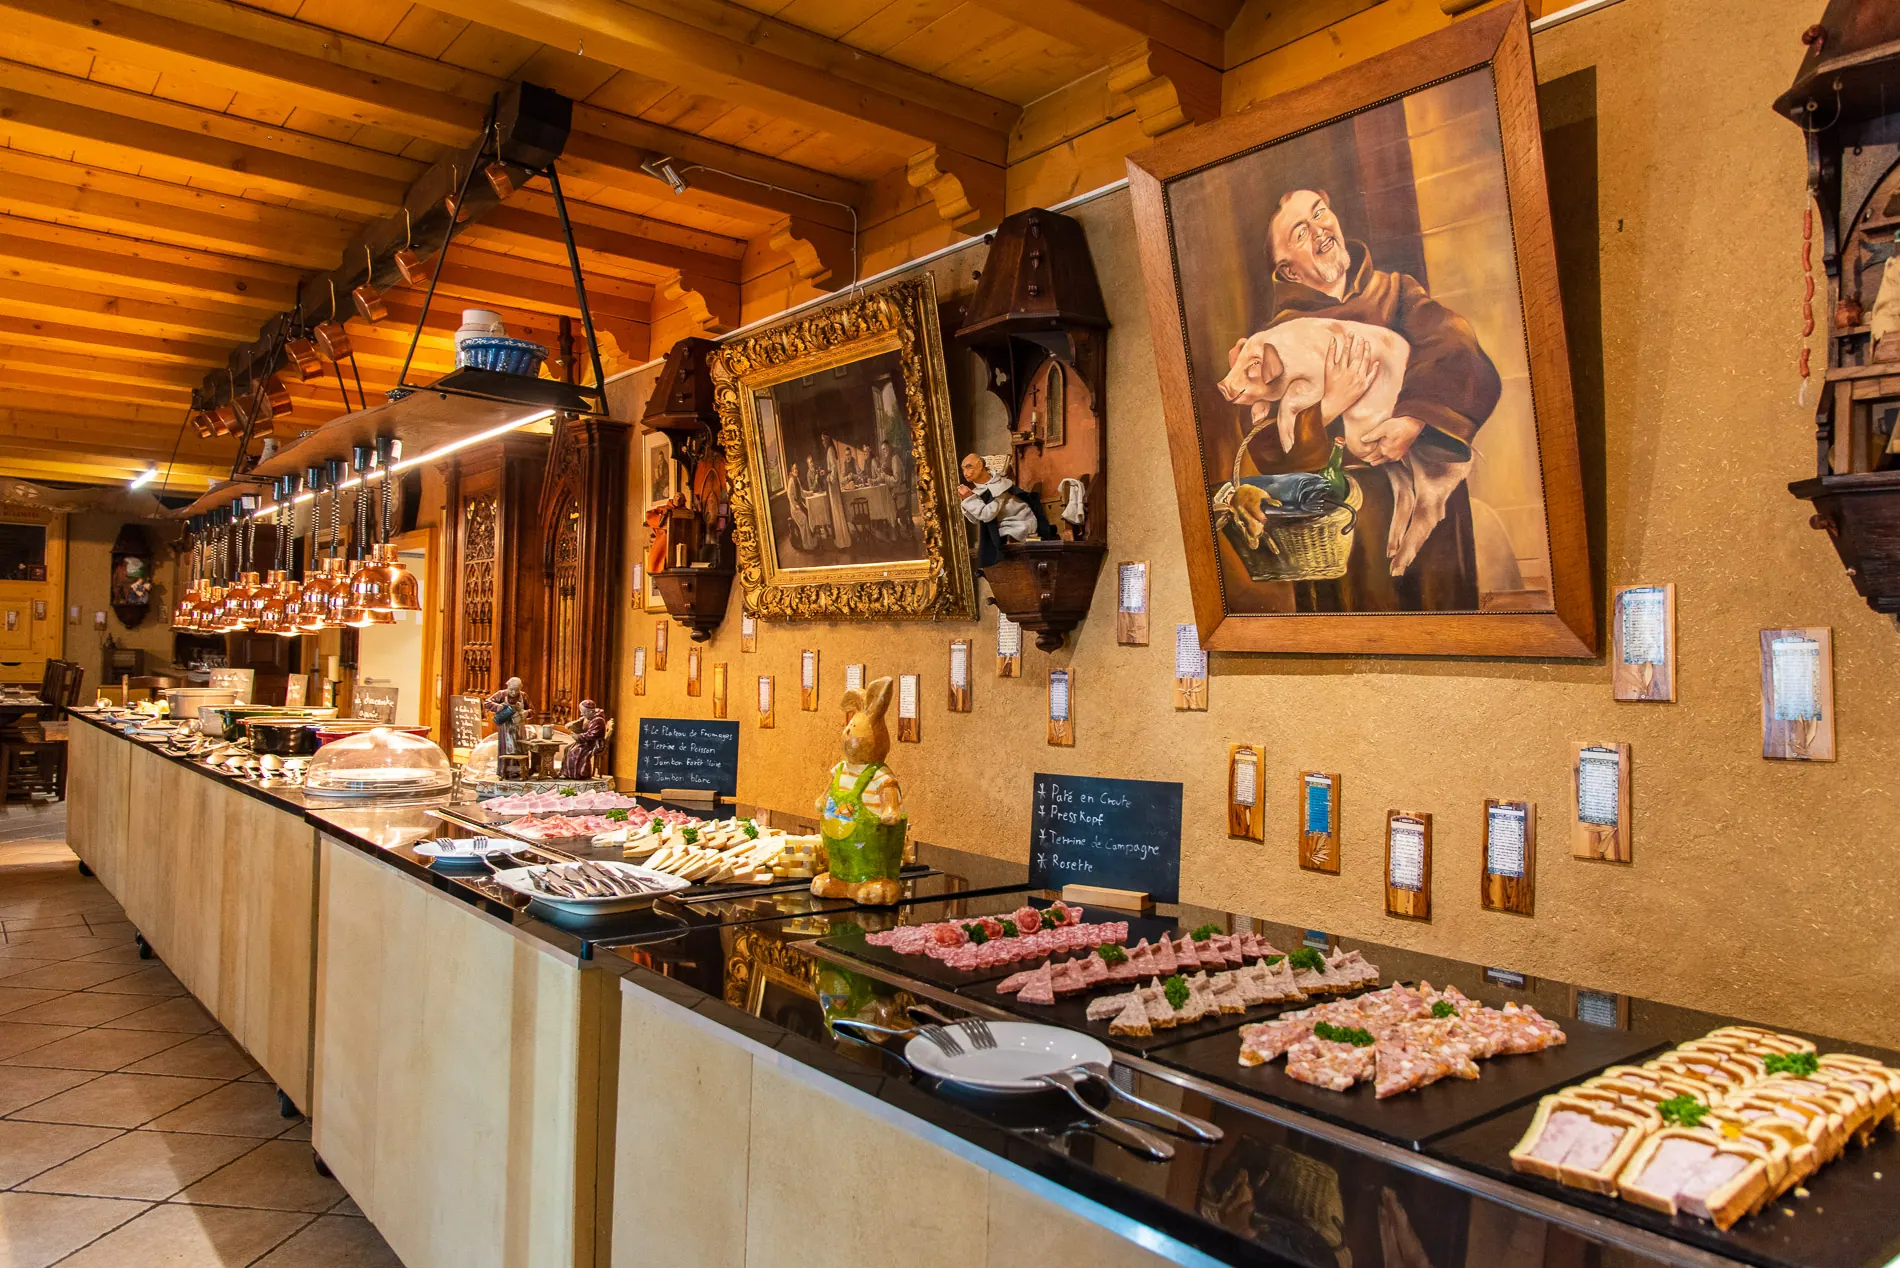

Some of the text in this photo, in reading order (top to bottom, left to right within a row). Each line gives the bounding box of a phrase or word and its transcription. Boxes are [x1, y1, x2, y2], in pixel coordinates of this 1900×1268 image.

[650, 725, 733, 742] Le Plateau de Fromages
[652, 740, 716, 754] Terrine de Poisson
[653, 756, 683, 766] Jambon
[654, 771, 685, 782] Jambon
[1080, 793, 1094, 803] en
[1049, 829, 1160, 861] Terrine de Campagne
[1052, 853, 1094, 873] Rosette
